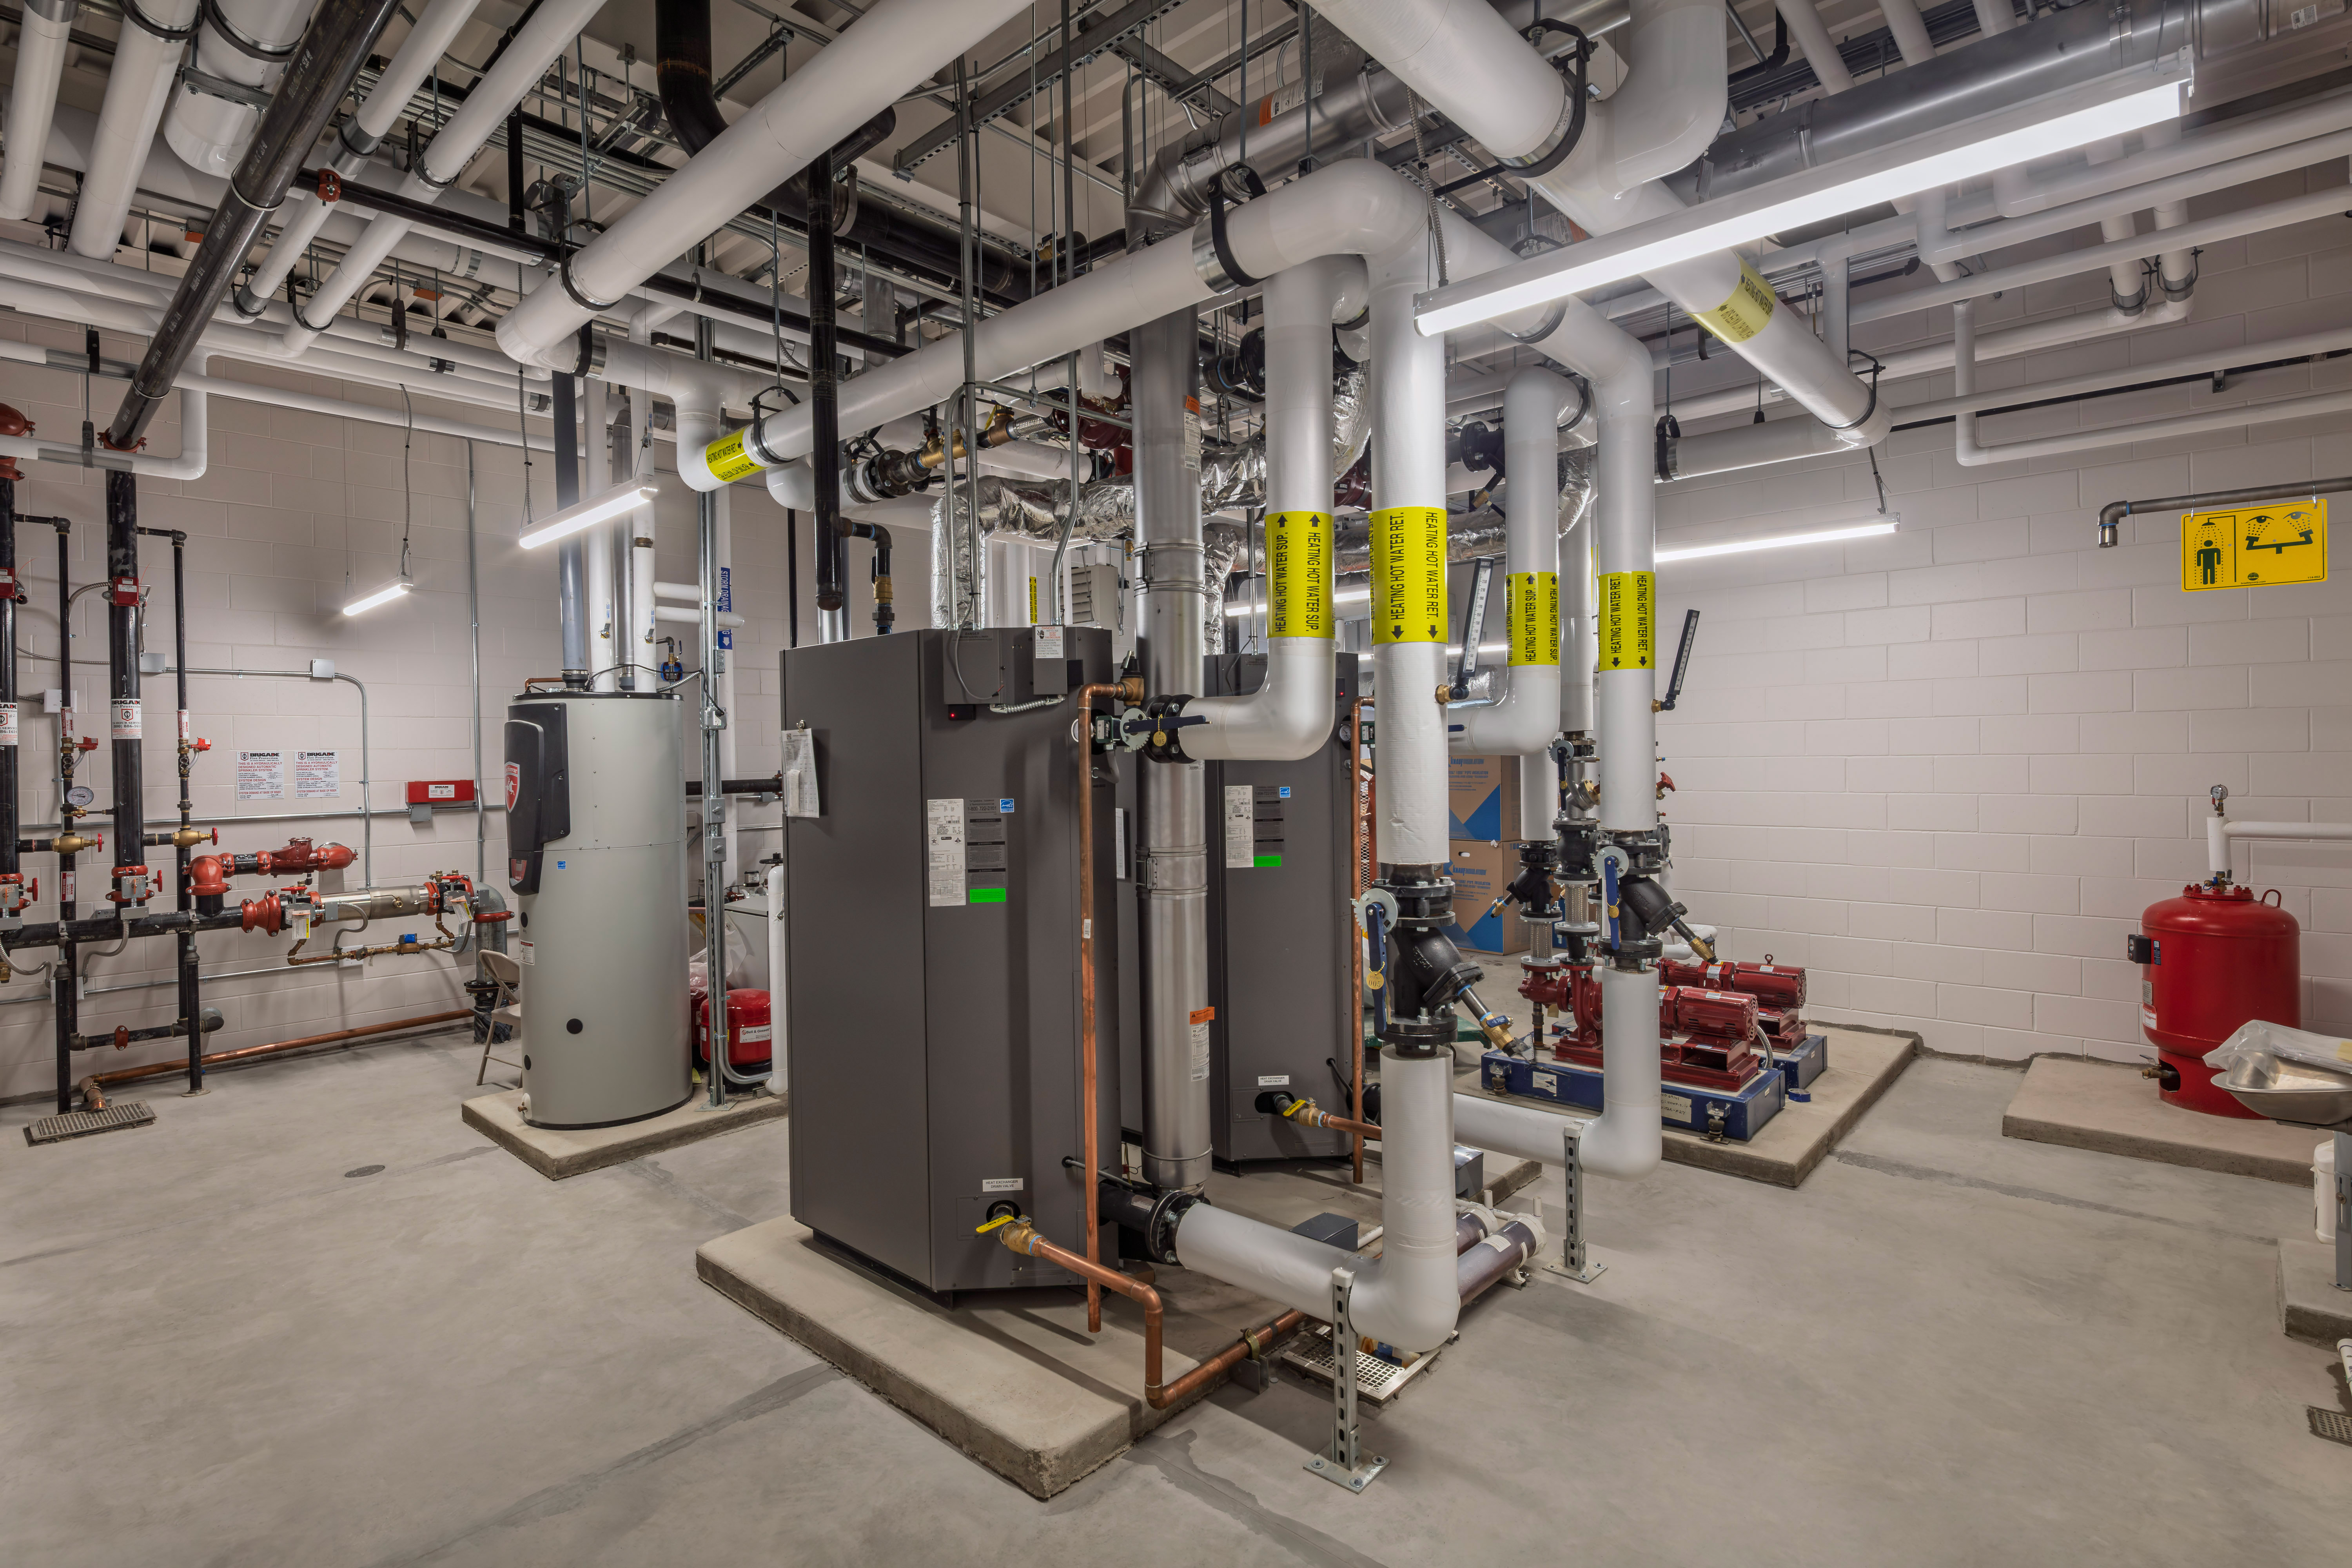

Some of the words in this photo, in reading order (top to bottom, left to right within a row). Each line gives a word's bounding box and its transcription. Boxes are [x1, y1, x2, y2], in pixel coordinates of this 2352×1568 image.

[707, 451, 717, 464] HEATING
[1390, 512, 1404, 531] RET.
[1426, 512, 1437, 548] HEATING
[1276, 532, 1288, 550] SUP.
[1307, 532, 1321, 566] HEATING
[1390, 533, 1404, 563] WATER
[1276, 552, 1287, 579] WATER
[1426, 550, 1438, 568] HOT
[1307, 568, 1320, 584] HOT
[1390, 566, 1405, 582] HOT
[1610, 576, 1621, 590] RET.
[1276, 580, 1287, 597] HOT
[1426, 570, 1438, 599] WATER
[1637, 575, 1647, 601] HEATING
[1306, 586, 1319, 612] WATER
[1390, 584, 1405, 620] HEATING
[1526, 588, 1536, 601] SUP.
[1610, 591, 1621, 613] WATER
[1275, 599, 1286, 632] HEATING
[1426, 601, 1438, 619] RET.
[1525, 603, 1536, 623] WATER
[1637, 603, 1647, 615] HOT
[1306, 614, 1319, 631] SUP.
[1610, 614, 1621, 627] HOT
[1637, 616, 1647, 638] WATER
[1525, 624, 1536, 636] HOT
[1525, 637, 1536, 662] HEATING
[1610, 628, 1621, 654] HEATING
[1638, 639, 1648, 652] RET.
[1450, 757, 1463, 767] KNAUF
[1453, 865, 1465, 876] KNAUF
[1369, 980, 1381, 988] 005
